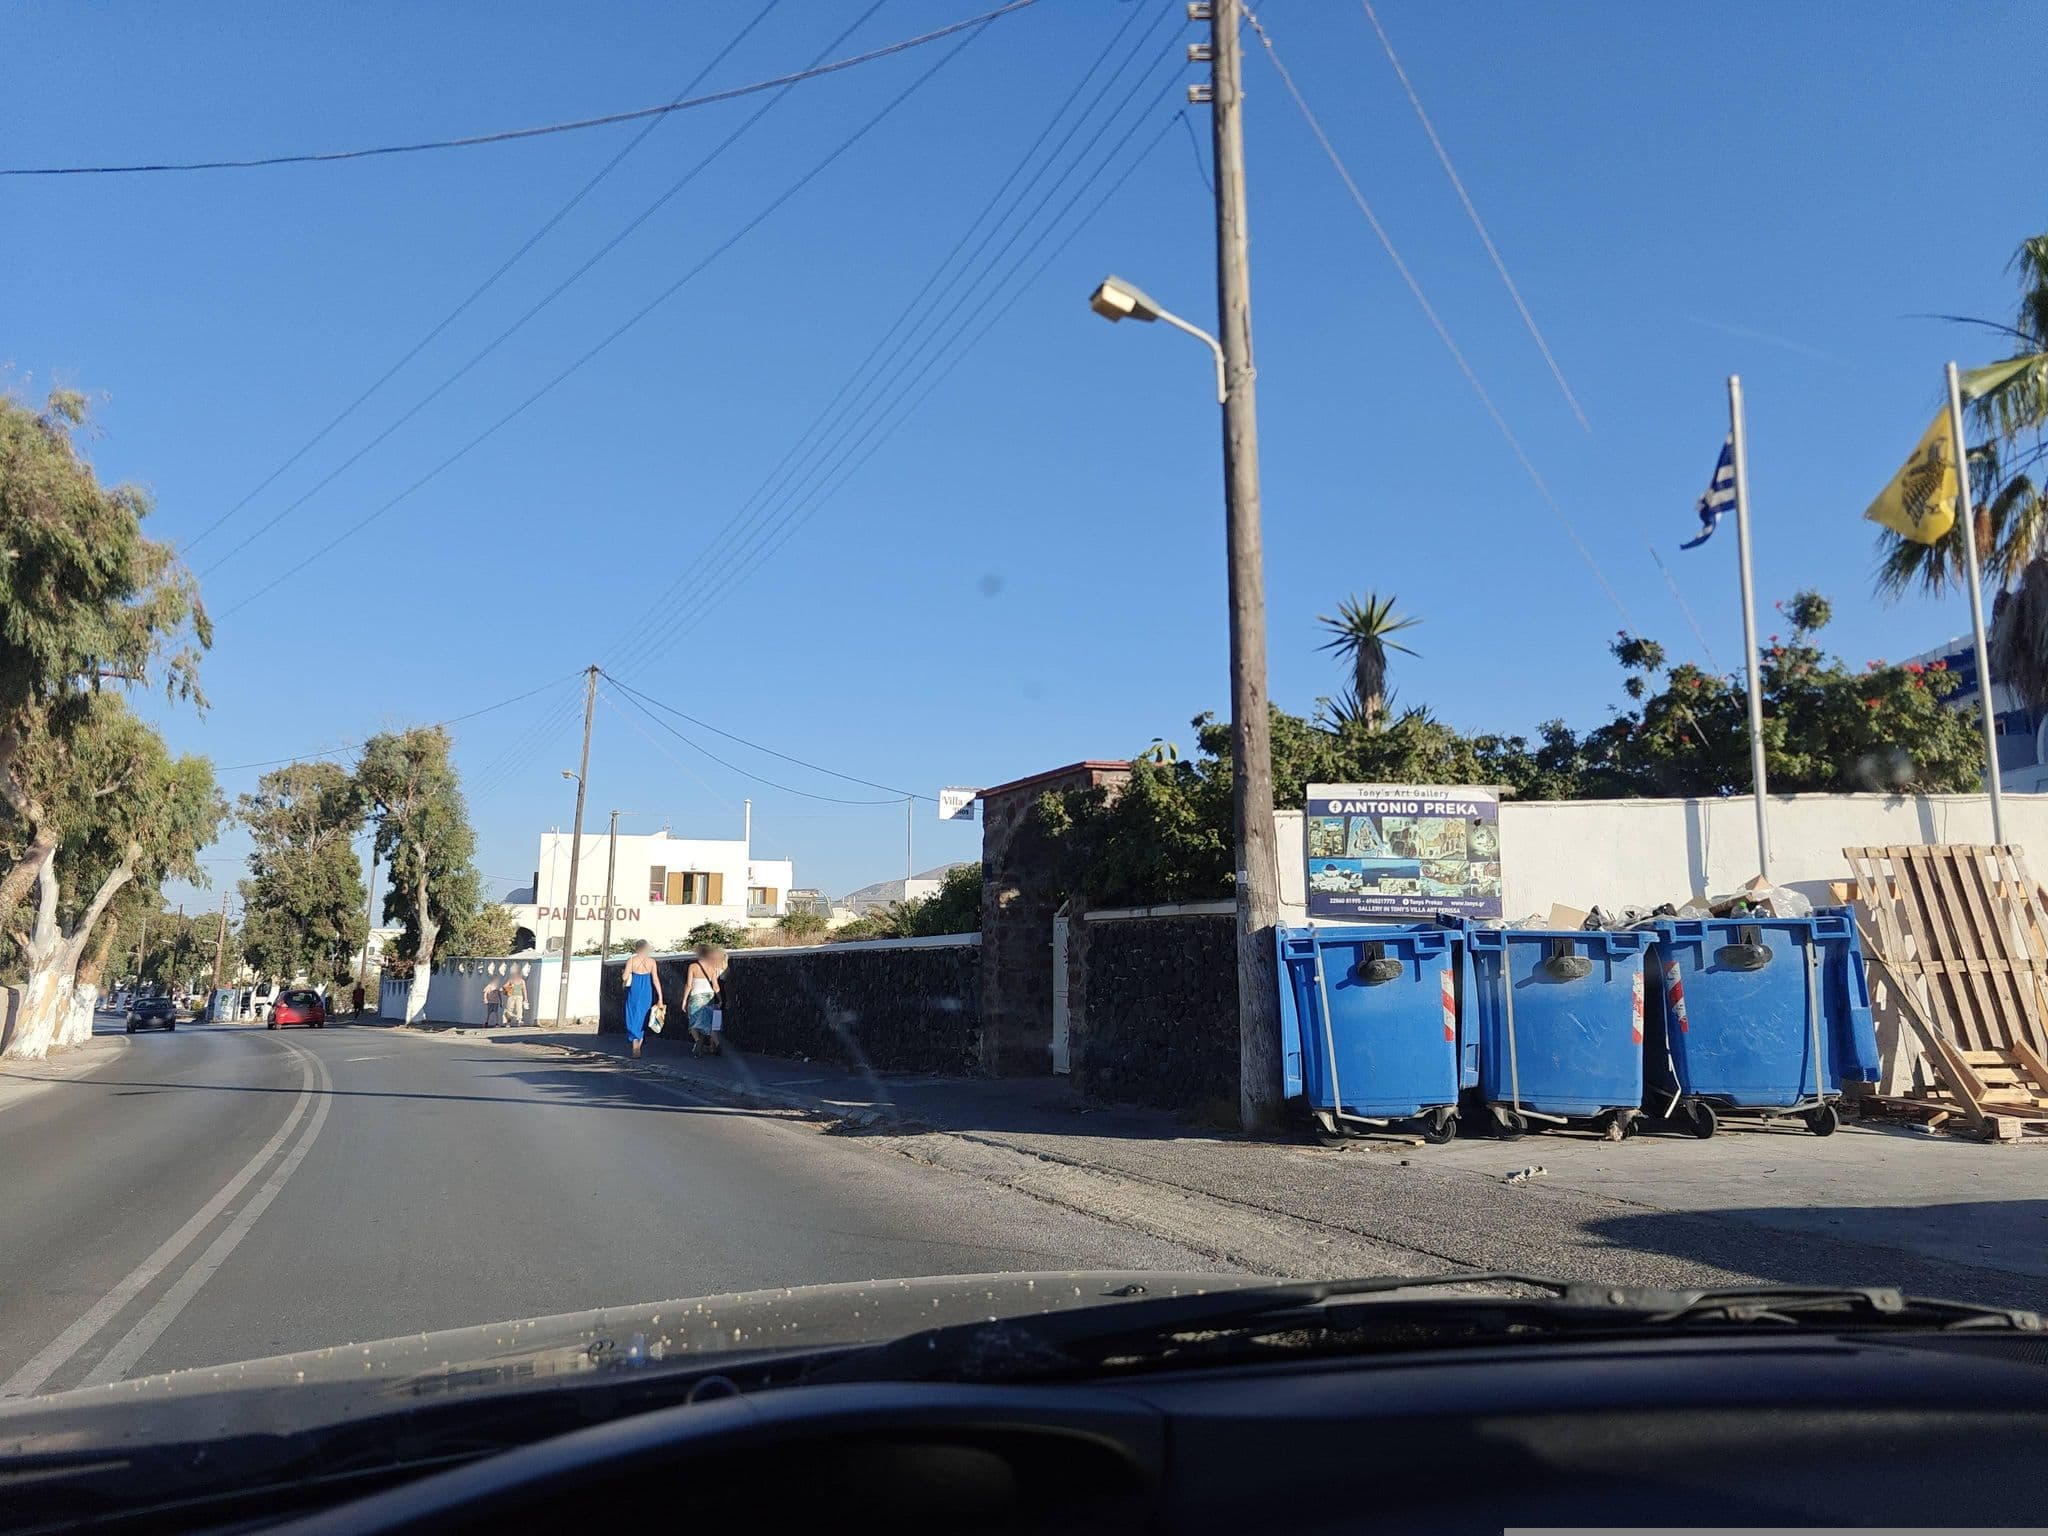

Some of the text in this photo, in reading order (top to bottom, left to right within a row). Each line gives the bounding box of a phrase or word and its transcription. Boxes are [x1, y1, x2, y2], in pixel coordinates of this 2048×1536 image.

[1358, 788, 1449, 799] Tony's Art Gallery
[942, 796, 963, 806] Villa
[1343, 801, 1478, 815] ANTONIO PREKA
